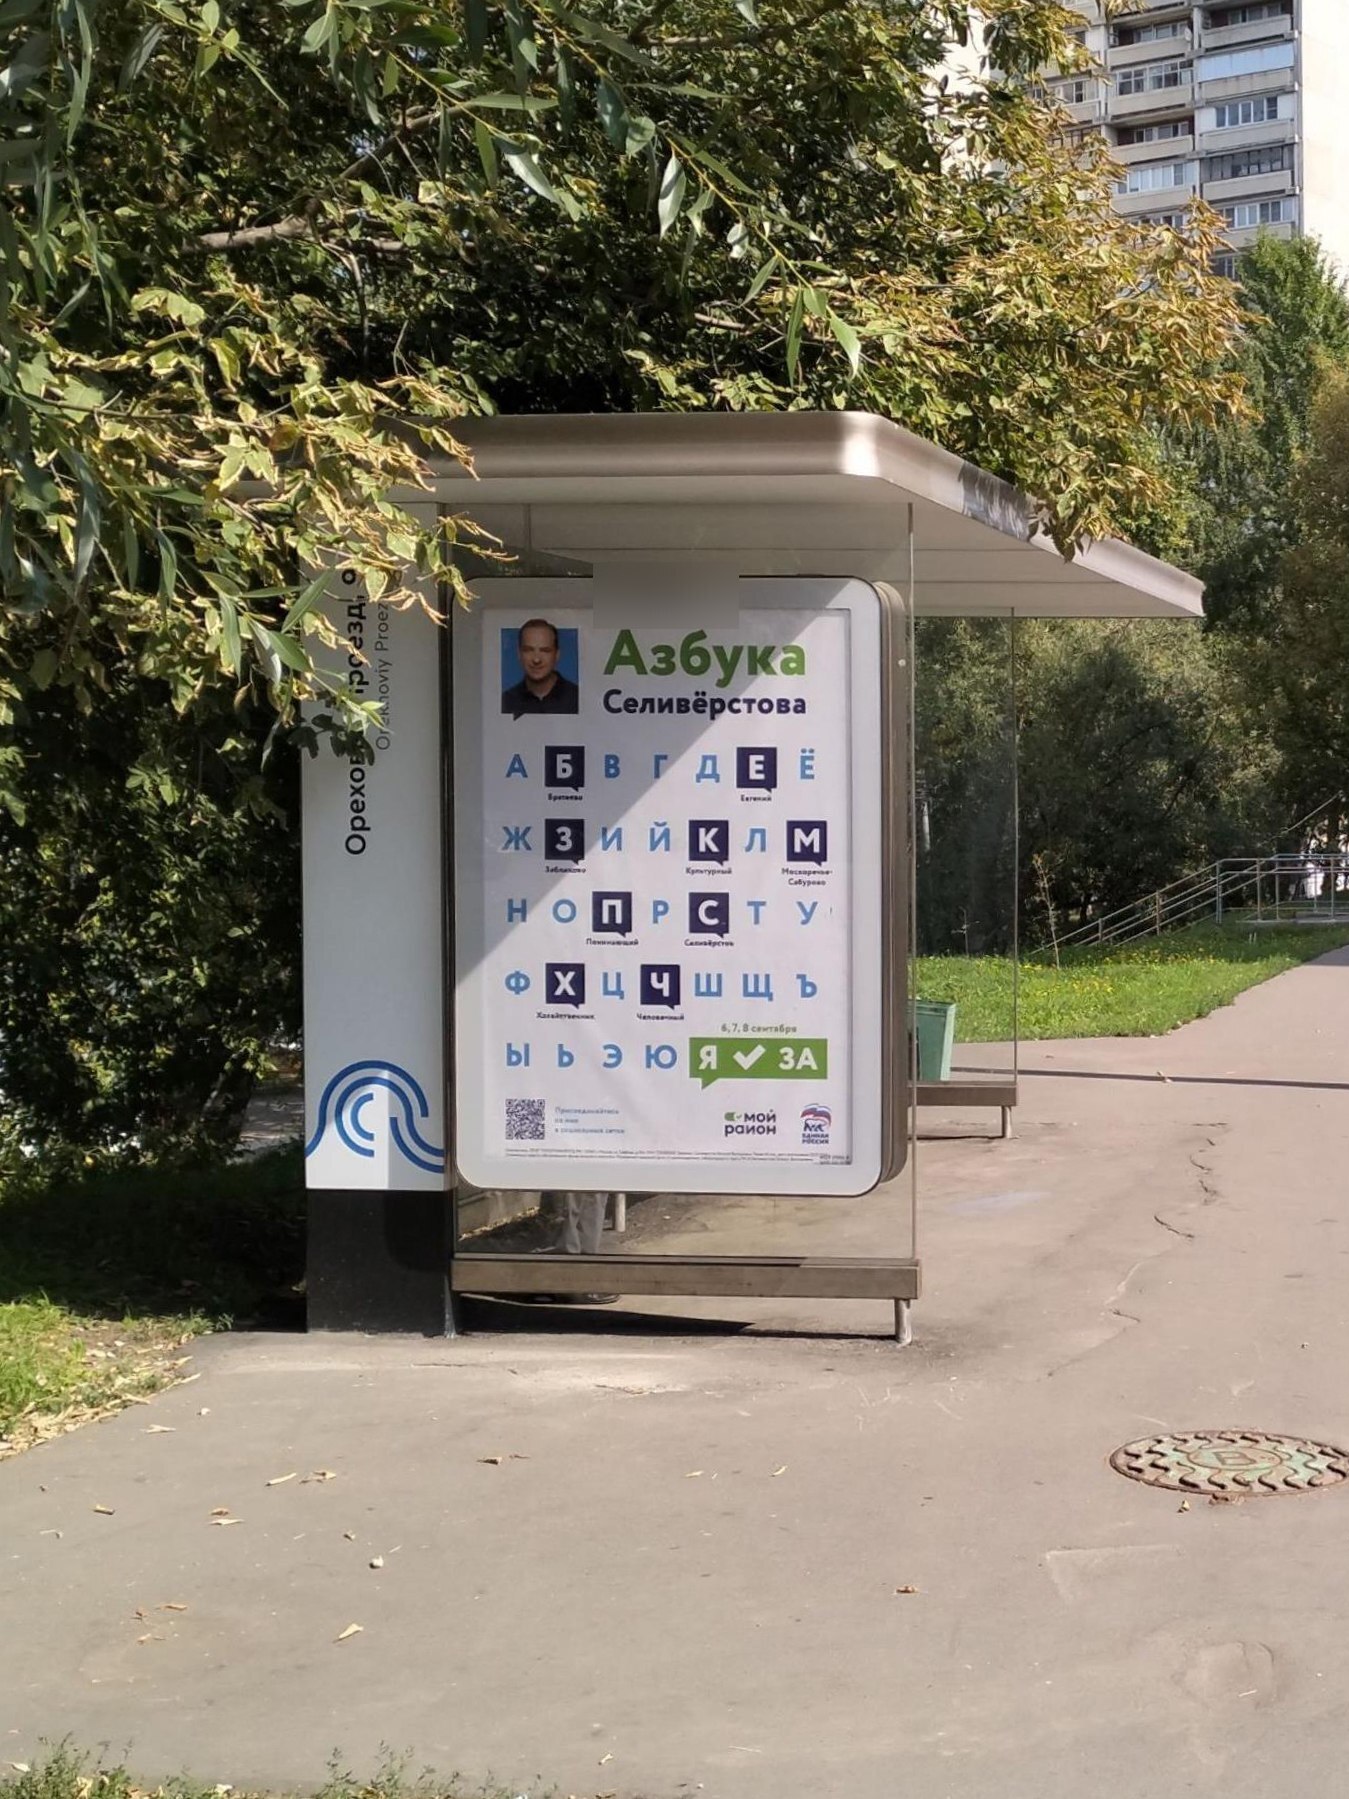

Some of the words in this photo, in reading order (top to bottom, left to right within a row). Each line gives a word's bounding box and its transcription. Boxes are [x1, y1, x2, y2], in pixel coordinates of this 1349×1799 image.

[375, 598, 389, 651] Proez
[603, 629, 806, 689] Азбука
[603, 689, 807, 720] Селивёрстова
[505, 754, 528, 779] А
[557, 754, 572, 778] Б
[604, 754, 620, 779] В
[653, 754, 668, 779] Г
[695, 754, 720, 783] Д
[749, 755, 765, 779] Е
[800, 748, 815, 780] Ё
[345, 714, 371, 856] Орехов
[503, 826, 532, 851] Ж
[556, 827, 572, 851] З
[601, 827, 622, 851] И
[649, 821, 670, 851] Й
[699, 828, 719, 852] К
[745, 828, 766, 852] Л
[794, 828, 819, 853] М
[506, 899, 527, 923] Н
[602, 899, 622, 924] П
[652, 900, 670, 924] Р
[699, 900, 719, 925] С
[747, 901, 767, 925] Т
[796, 901, 818, 925] У
[504, 970, 531, 995] Ф
[555, 971, 575, 995] Х
[602, 972, 624, 1000] Ц
[651, 972, 669, 997] Ч
[694, 973, 723, 998] Ш
[742, 973, 774, 1001] Щ
[796, 974, 818, 998] Ъ
[721, 1023, 731, 1035] 6,
[732, 1024, 742, 1035] 7,
[743, 1024, 750, 1033] 8
[751, 1025, 797, 1036] сентября
[505, 1043, 530, 1068] Ы
[558, 1043, 575, 1068] Ь
[602, 1044, 623, 1069] Э
[645, 1044, 678, 1070] Ю
[699, 1045, 717, 1069] Я
[779, 1047, 818, 1070] ЗА
[743, 1109, 777, 1123] мой
